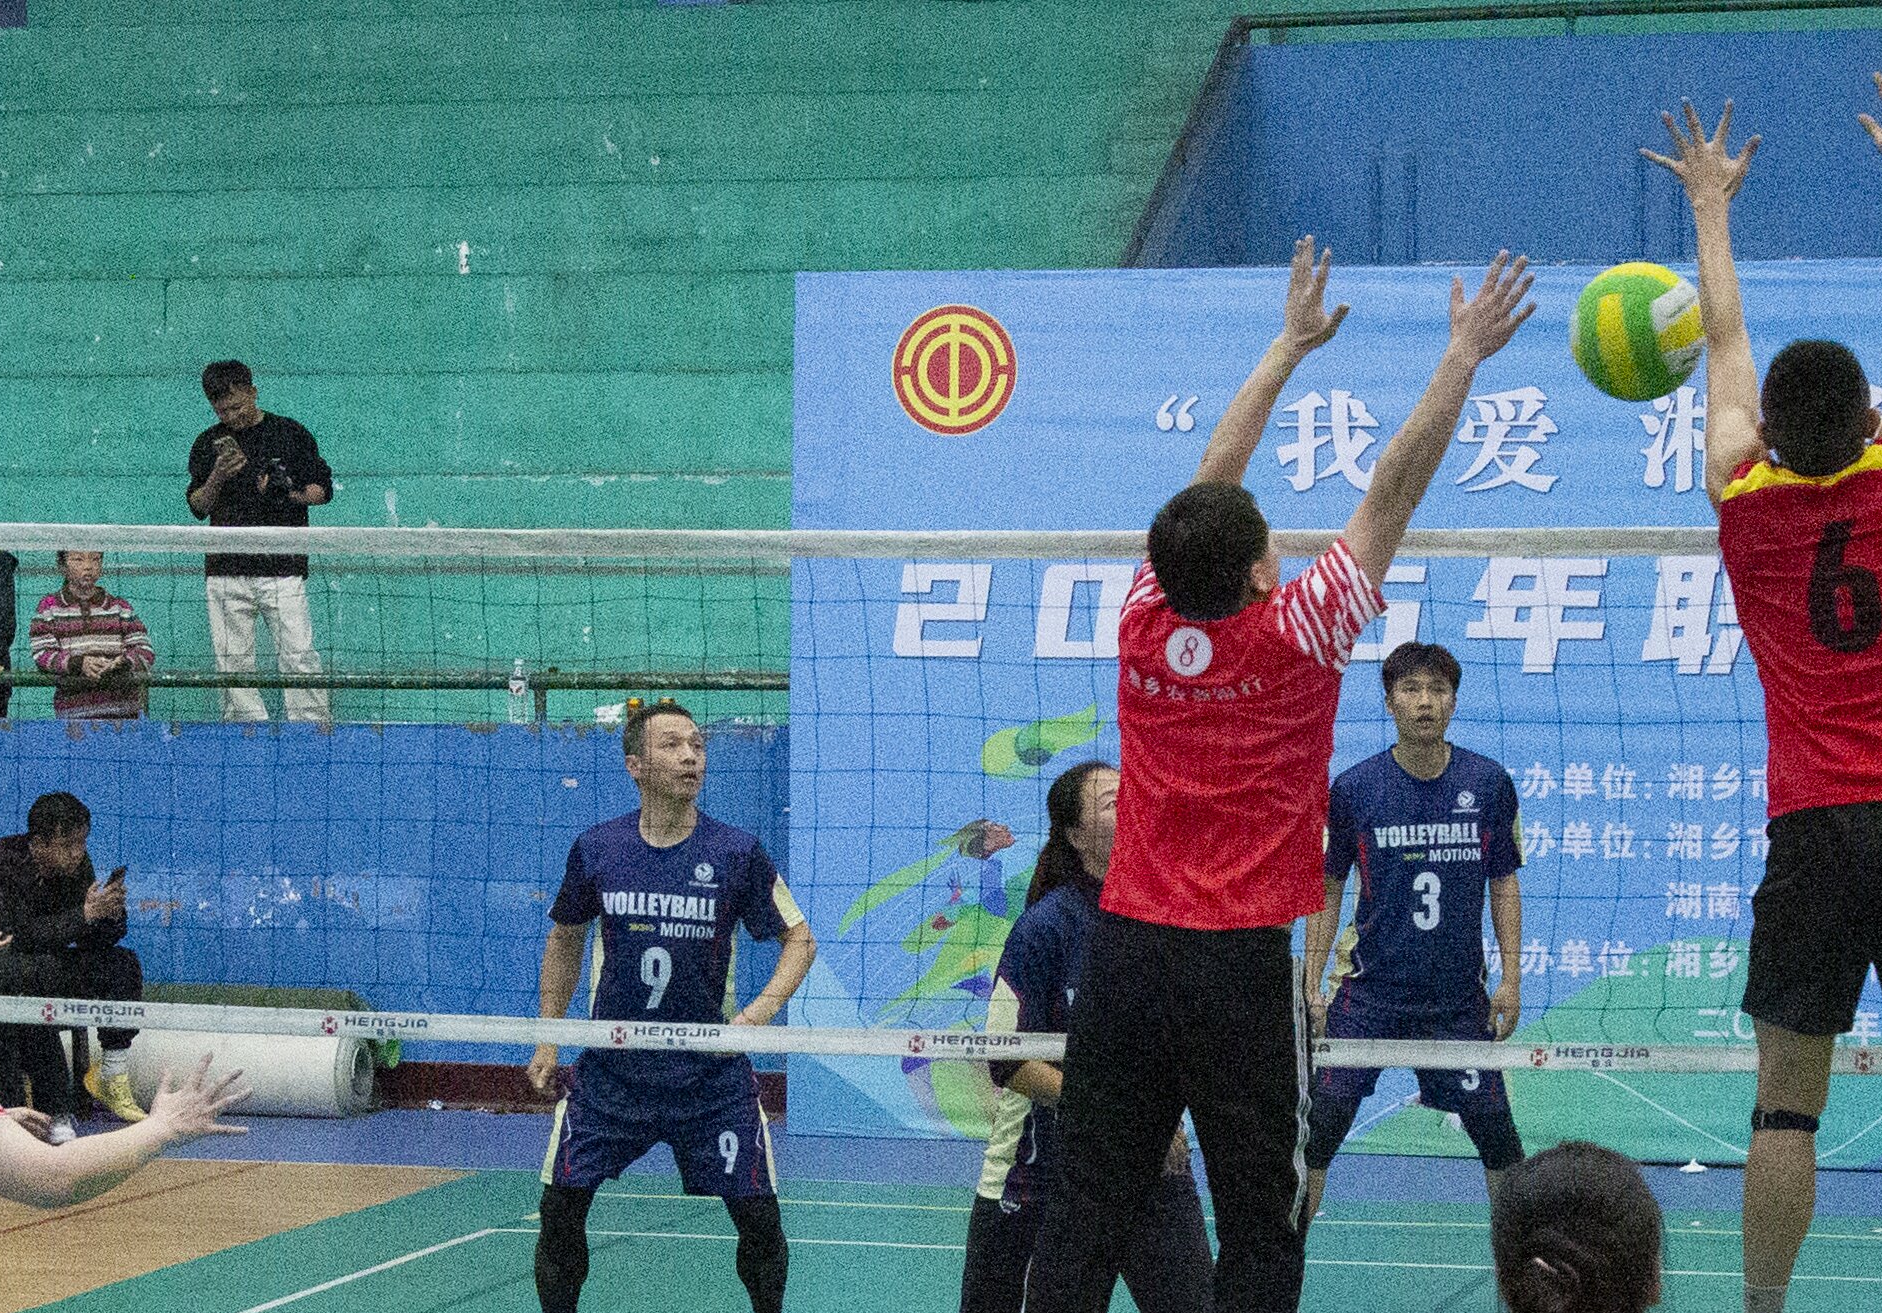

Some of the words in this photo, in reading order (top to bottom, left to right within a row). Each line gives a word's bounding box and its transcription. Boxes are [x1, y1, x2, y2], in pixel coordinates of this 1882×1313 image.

[1178, 635, 1199, 668] 8
[1373, 822, 1481, 848] VOLLEYBALL
[1429, 847, 1482, 862] MOTION
[602, 890, 717, 922] VOLLEYBALL
[1412, 870, 1442, 931] 3
[659, 921, 716, 939] MOTION
[639, 945, 674, 1011] 9
[63, 1001, 147, 1018] HENGJIA
[343, 1016, 430, 1032] HENGJIA
[632, 1025, 722, 1039] HENGJIA
[932, 1035, 1022, 1047] HENGJIA
[1554, 1045, 1652, 1060] HENGJIA
[718, 1130, 740, 1175] 9
